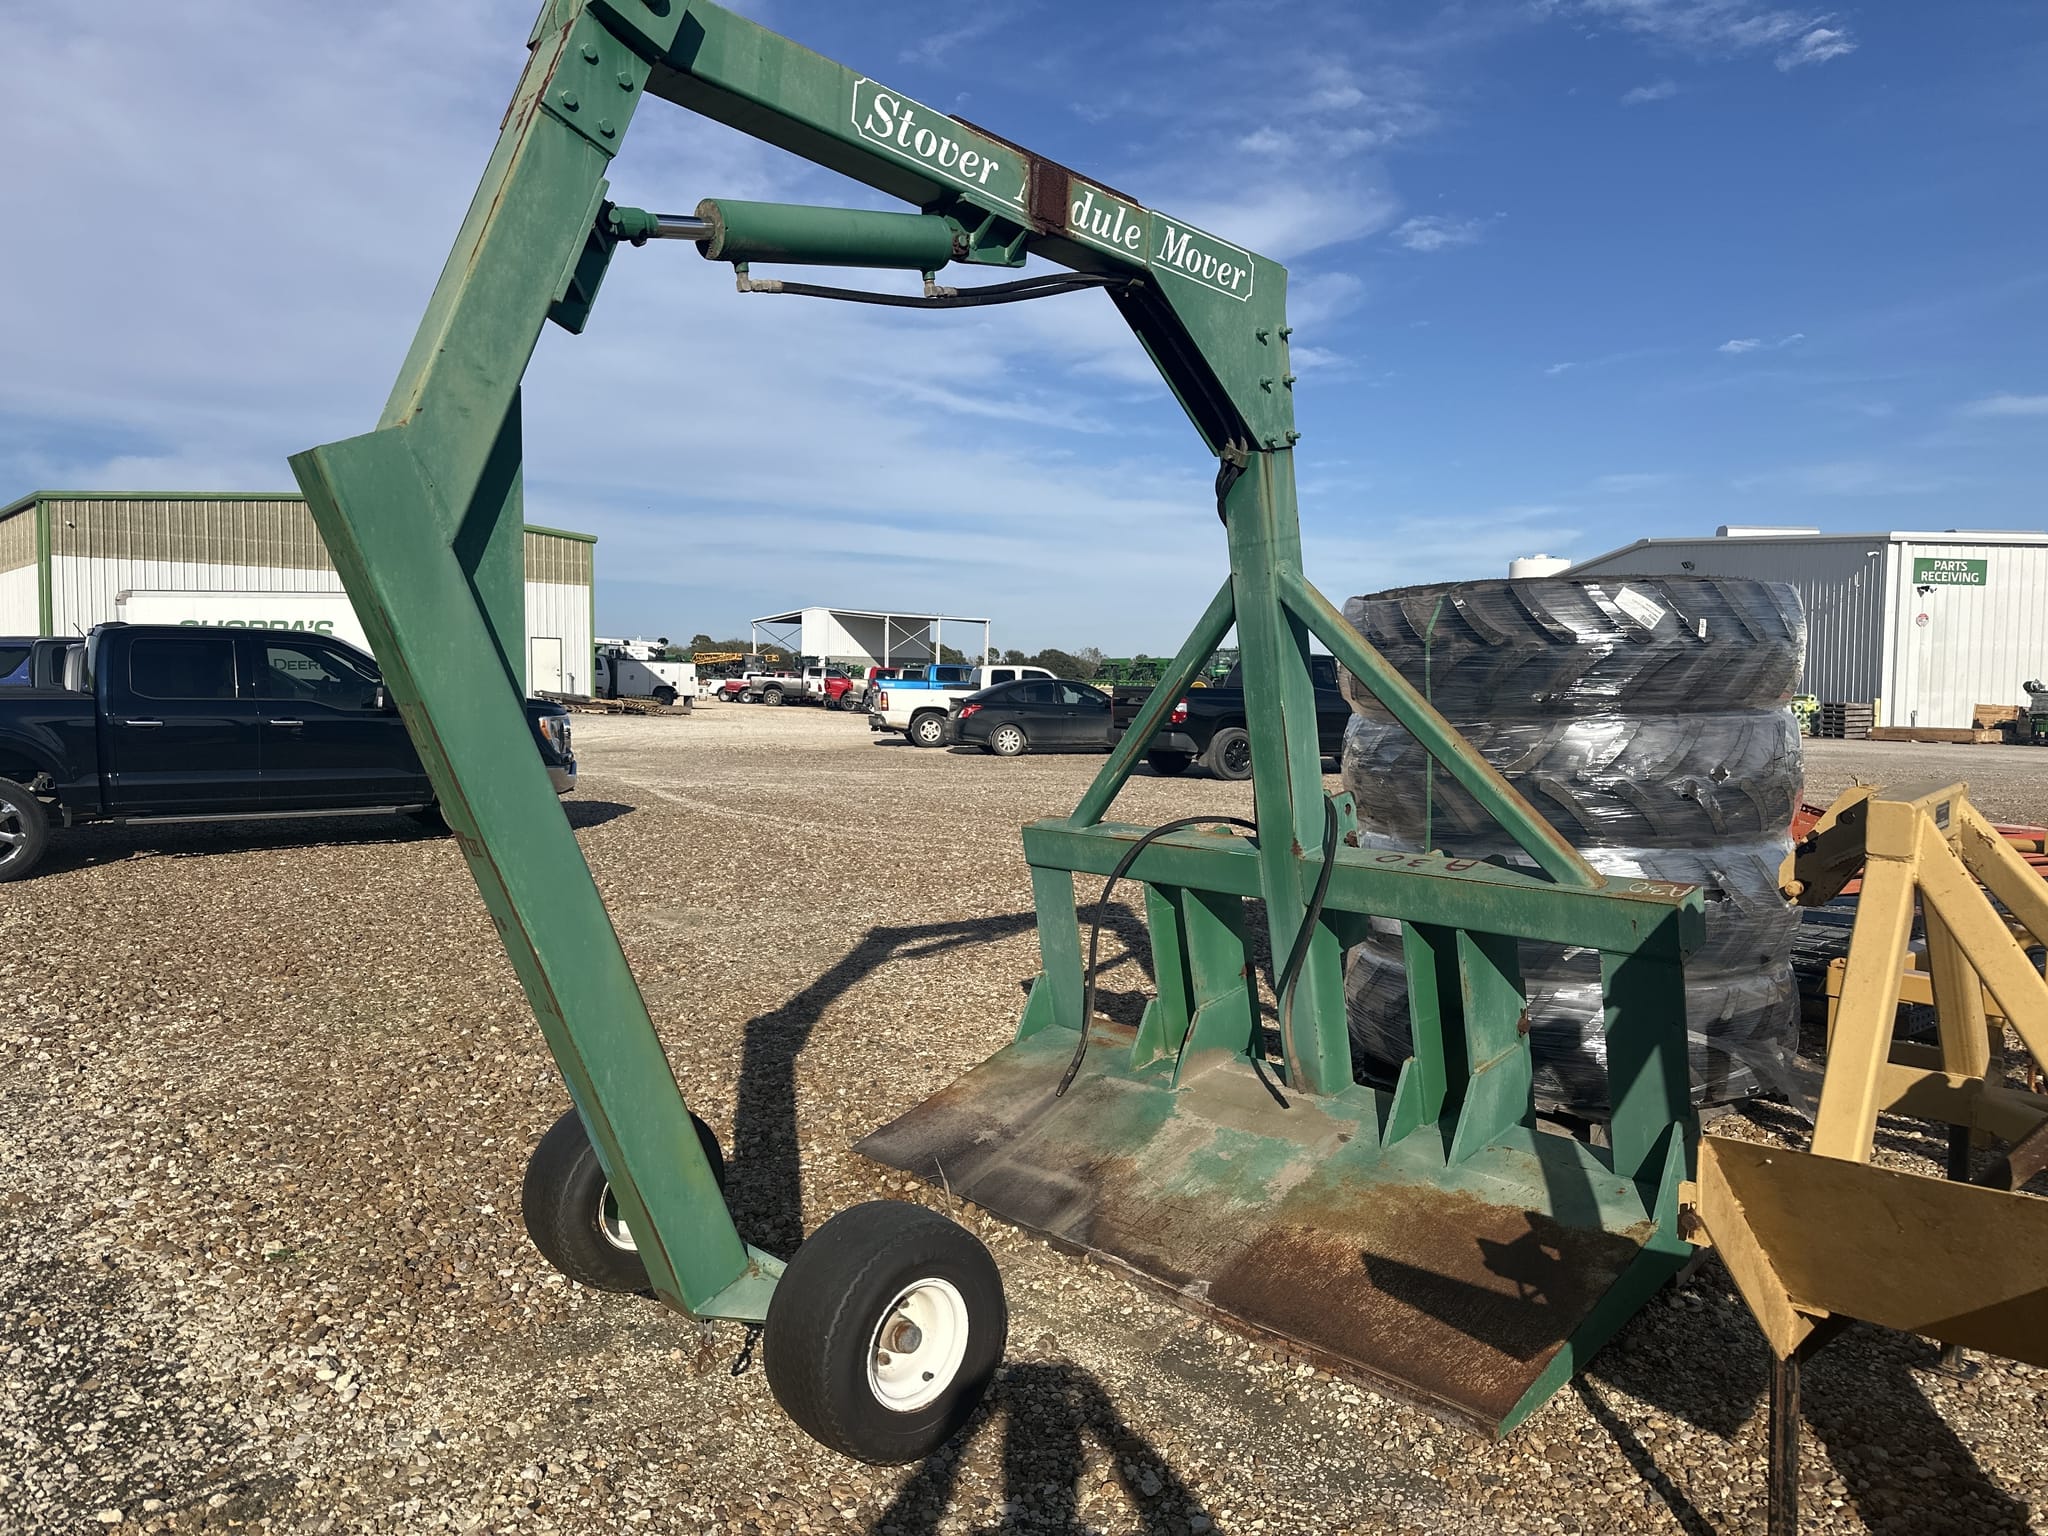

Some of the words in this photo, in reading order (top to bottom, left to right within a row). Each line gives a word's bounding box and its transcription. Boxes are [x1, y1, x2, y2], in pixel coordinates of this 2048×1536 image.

[864, 92, 999, 184] Stover
[1155, 225, 1246, 290] Mover
[1934, 561, 1968, 571] PARTS
[1921, 571, 1980, 583] RECEIVING
[273, 658, 322, 671] DEER
